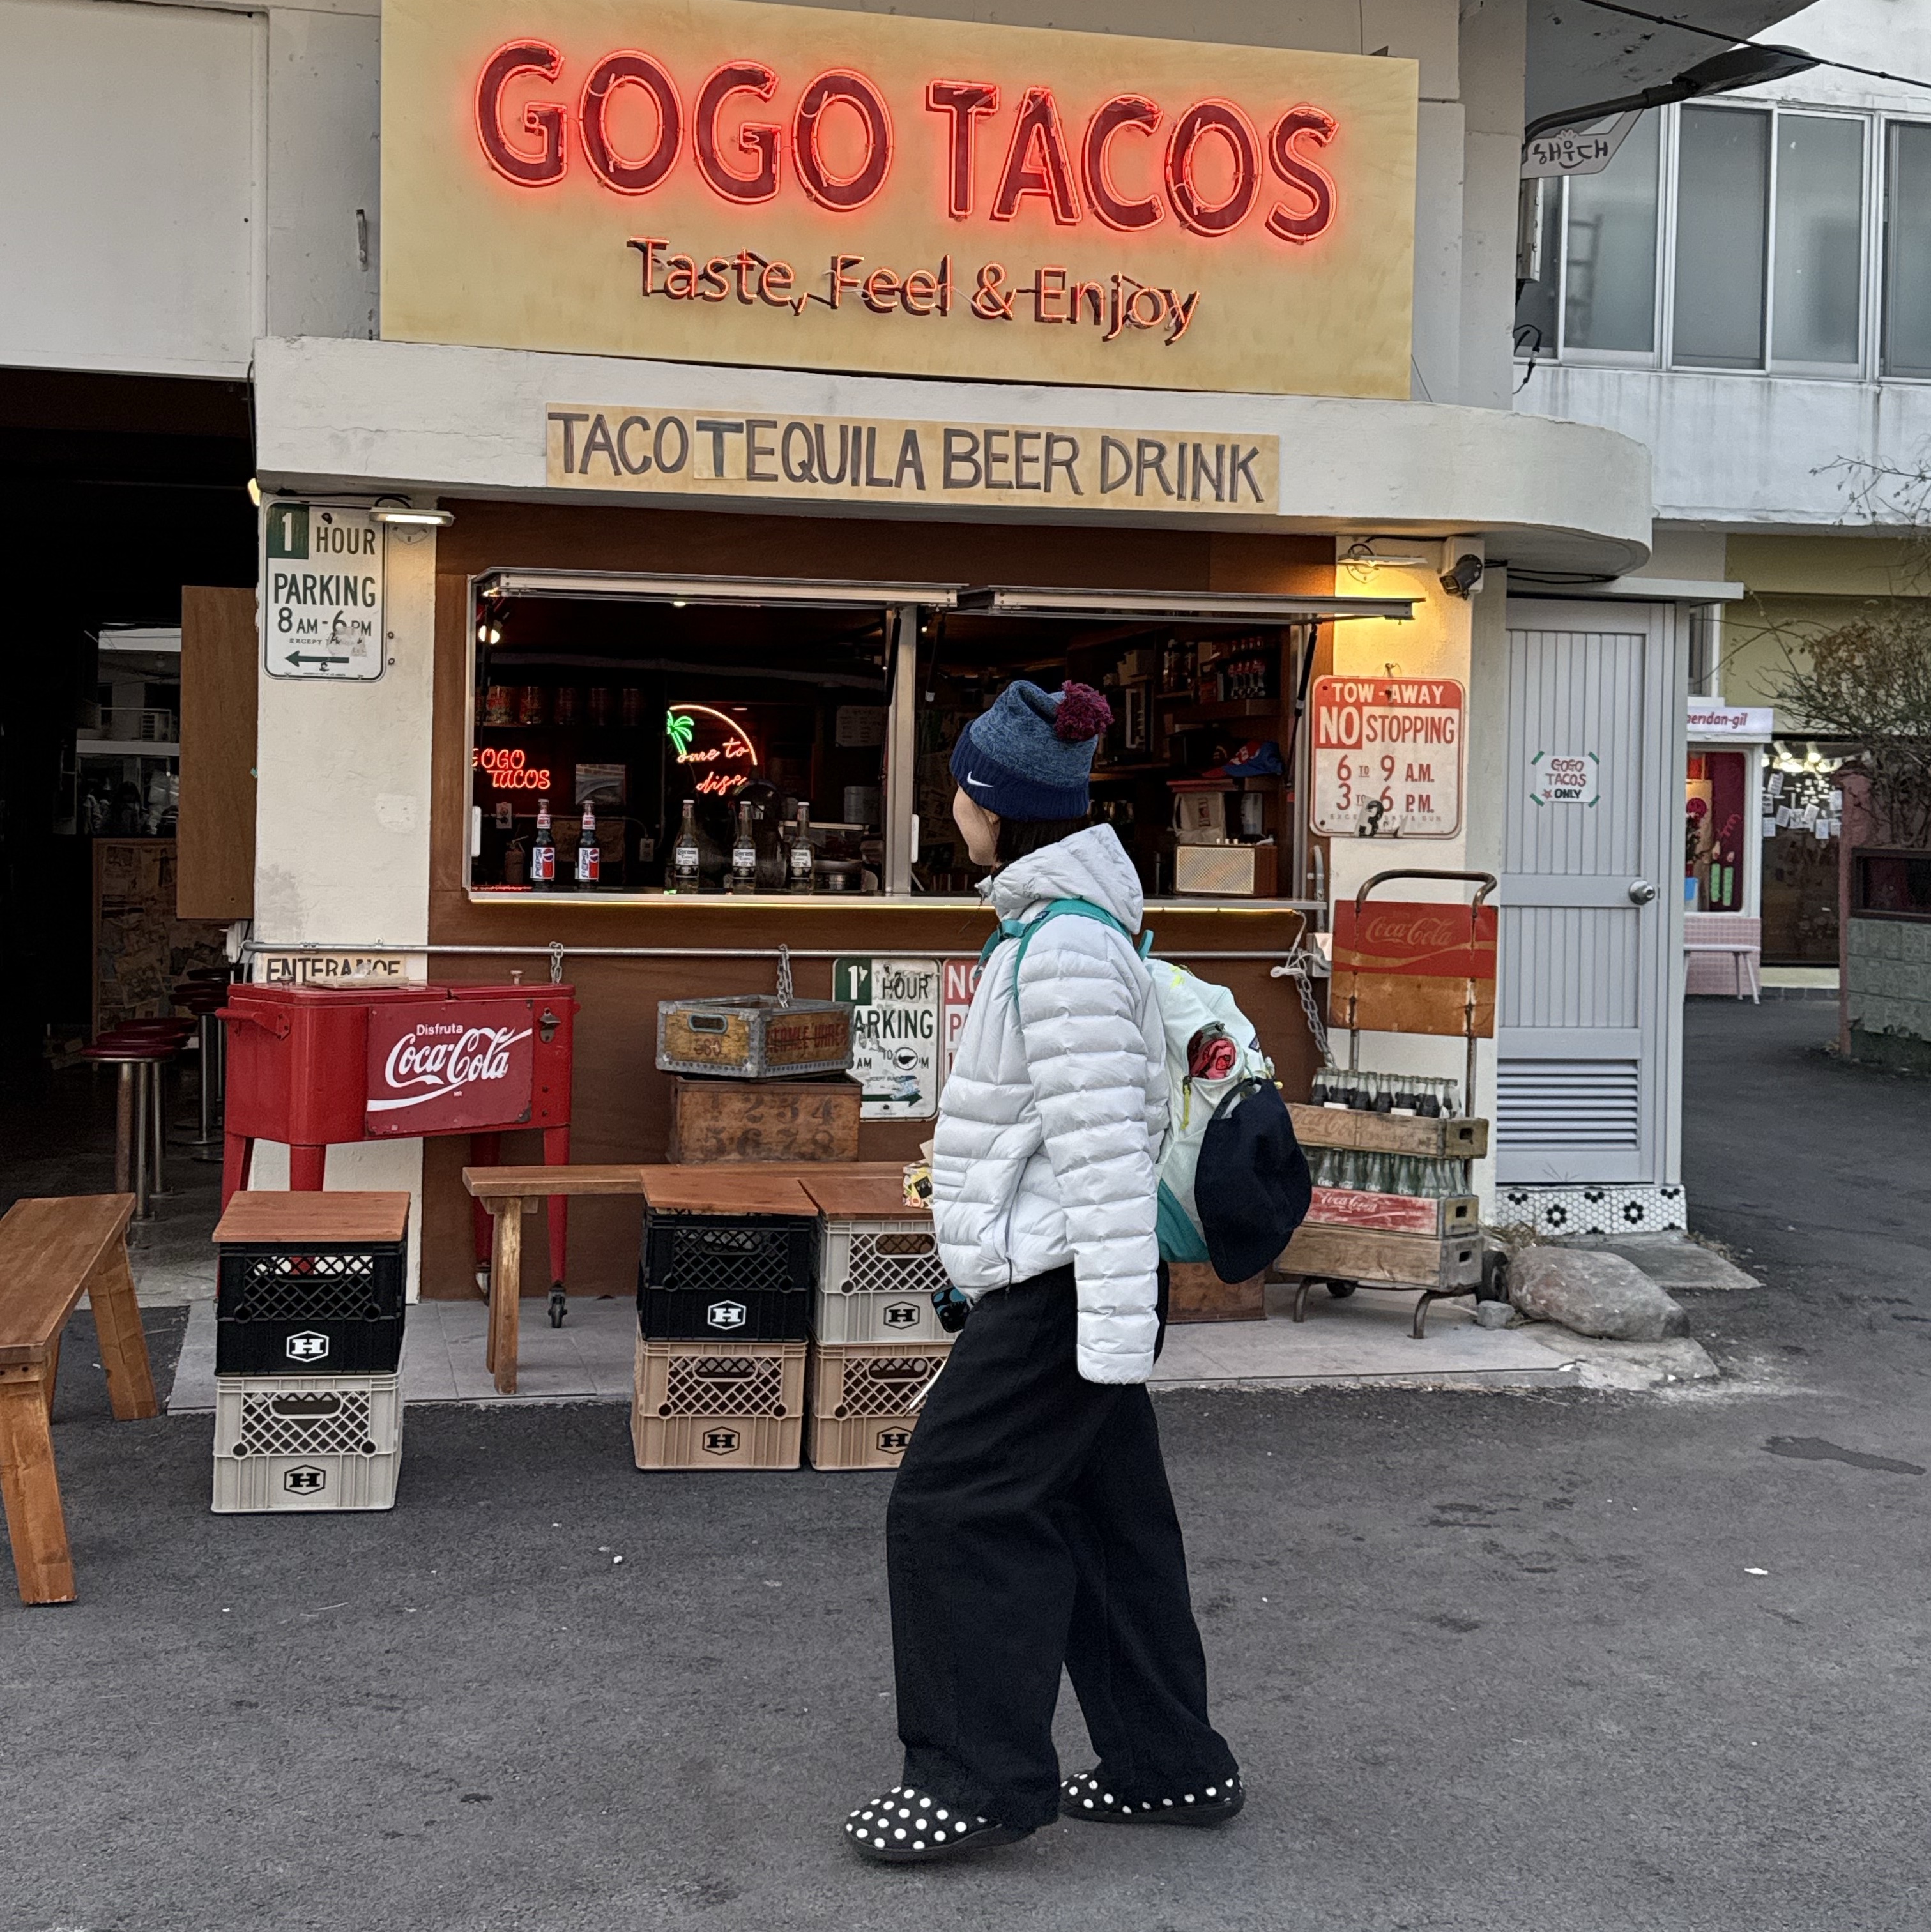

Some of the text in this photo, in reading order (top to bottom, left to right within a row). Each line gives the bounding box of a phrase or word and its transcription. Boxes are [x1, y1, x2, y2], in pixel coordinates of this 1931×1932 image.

[473, 37, 1339, 245] GOGO TACOS
[1532, 139, 1608, 169] 해운대
[627, 236, 1200, 346] Taste, Feel & Enjoy
[547, 411, 1266, 505] TACO TEQUILA BEER DRINK
[282, 512, 376, 555] 1 HOUR
[273, 573, 376, 608] PARKING
[277, 607, 293, 633] 8
[296, 618, 318, 634] AM
[1320, 706, 1454, 745] NO STOPPING
[722, 737, 749, 758] to
[1337, 754, 1435, 782] 6 TO 9 A.M.
[1551, 758, 1584, 772] GOGO
[486, 769, 551, 789] TACOS
[1545, 773, 1587, 787] TACOS
[1336, 782, 1351, 811] 3
[1380, 786, 1394, 812] 6
[1406, 794, 1434, 813] P.M.
[1554, 788, 1582, 799] ONLY
[1365, 916, 1456, 947] Coca-Cola
[882, 975, 928, 1000] HOUR
[416, 1024, 464, 1036] Disfruta
[854, 1009, 933, 1039] ARKING
[385, 1027, 516, 1088] Coca-Cola
[712, 1307, 742, 1322] H
[885, 1309, 916, 1322] H
[292, 1339, 323, 1355] H
[706, 1434, 736, 1448] H
[289, 1473, 320, 1488] H
